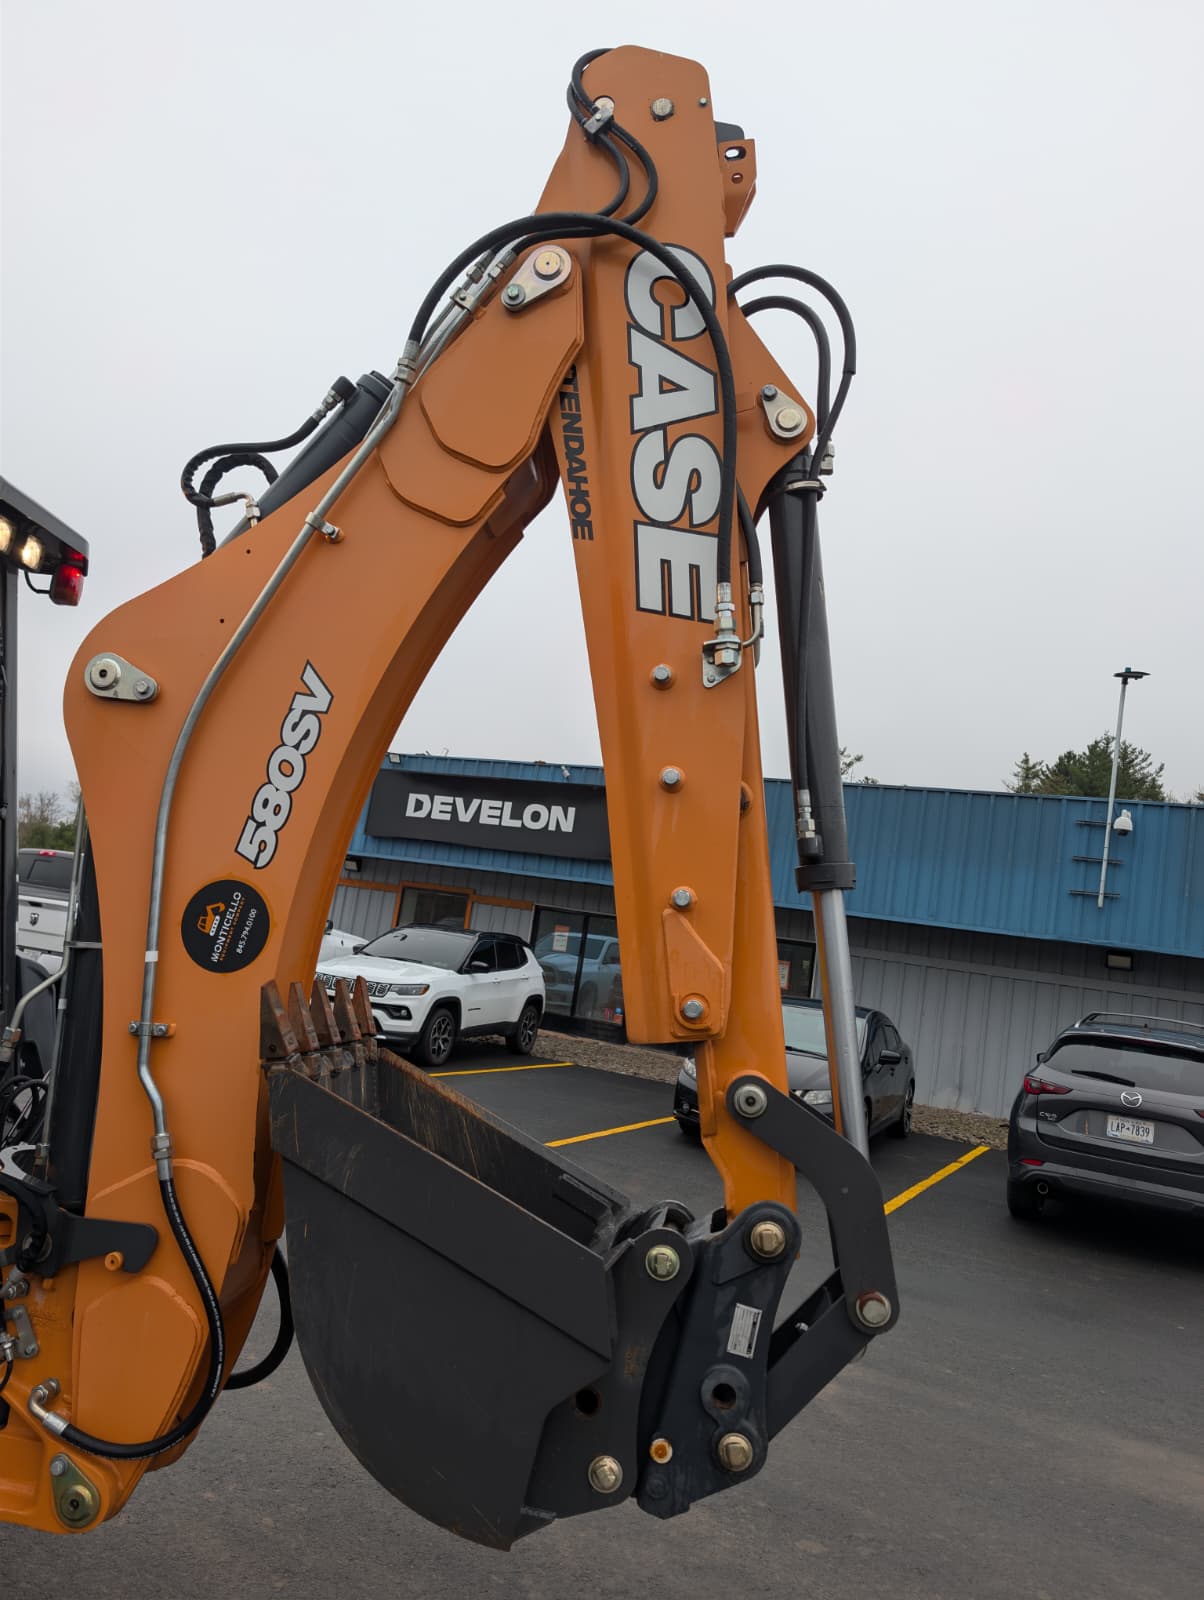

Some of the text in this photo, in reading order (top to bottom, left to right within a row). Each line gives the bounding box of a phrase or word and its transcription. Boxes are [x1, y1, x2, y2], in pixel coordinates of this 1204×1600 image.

[624, 243, 722, 624] CASE
[234, 659, 334, 870] 580SV
[405, 793, 576, 833] DEVELON
[210, 891, 242, 963] MONTICELLO
